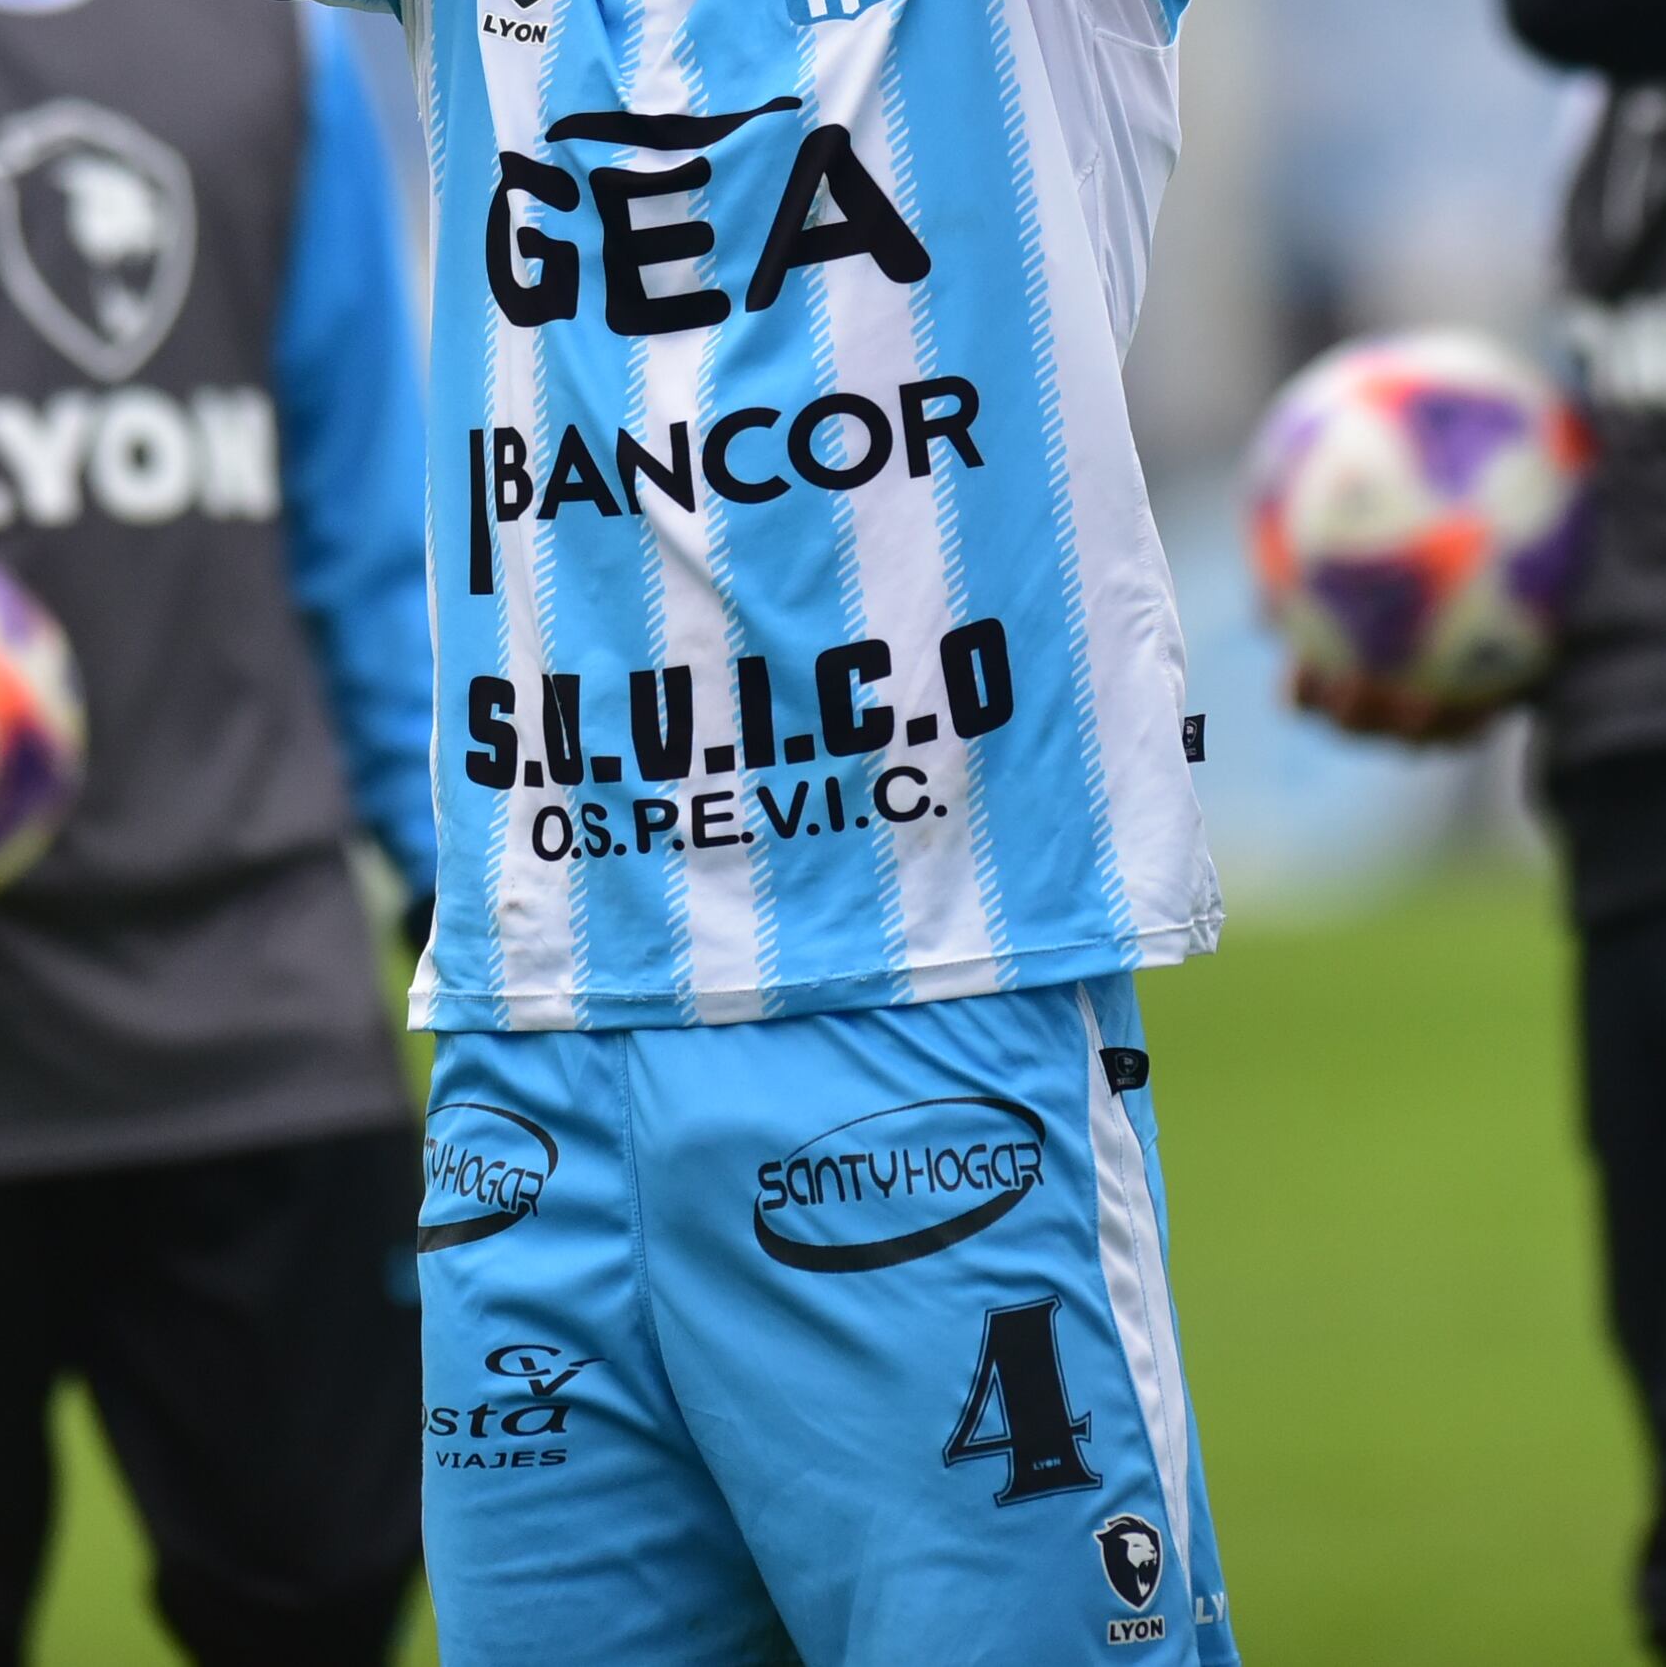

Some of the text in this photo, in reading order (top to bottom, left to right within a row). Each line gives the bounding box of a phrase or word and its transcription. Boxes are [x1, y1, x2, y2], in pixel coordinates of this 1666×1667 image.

[483, 14, 548, 43] LYON
[486, 125, 931, 336] GEA
[493, 376, 984, 522] BANCOR
[533, 766, 948, 862] O.S.P.E.V.I.C.
[942, 1294, 1103, 1508] 4
[436, 1449, 567, 1469] VIAJES
[1109, 1618, 1164, 1642] LYON
[1194, 1592, 1226, 1625] LY
